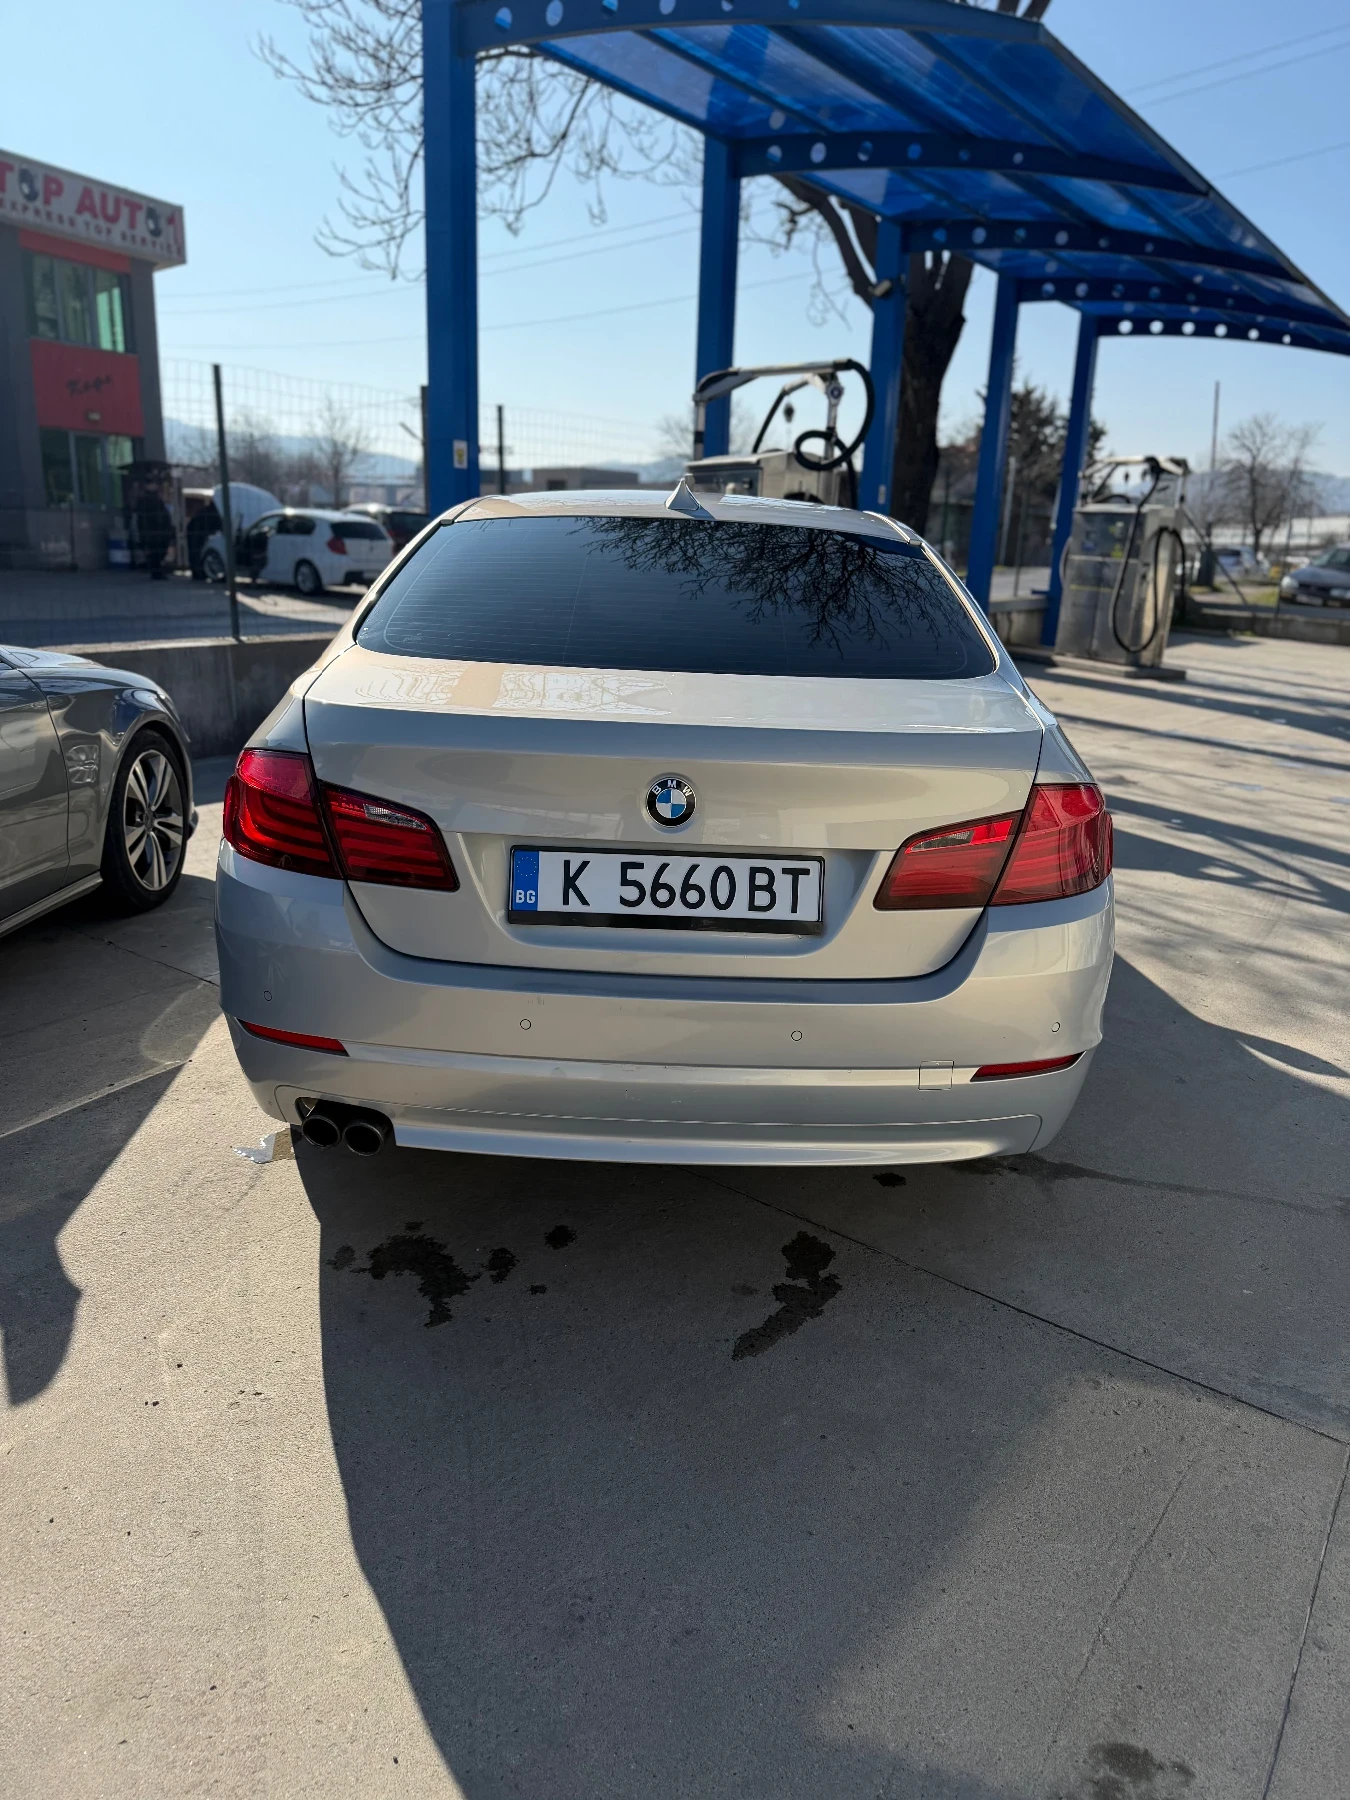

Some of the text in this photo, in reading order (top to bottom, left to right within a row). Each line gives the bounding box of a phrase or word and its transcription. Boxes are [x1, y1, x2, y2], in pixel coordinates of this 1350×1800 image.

[651, 779, 692, 797] BMW
[562, 860, 591, 906] K
[515, 889, 536, 904] BG
